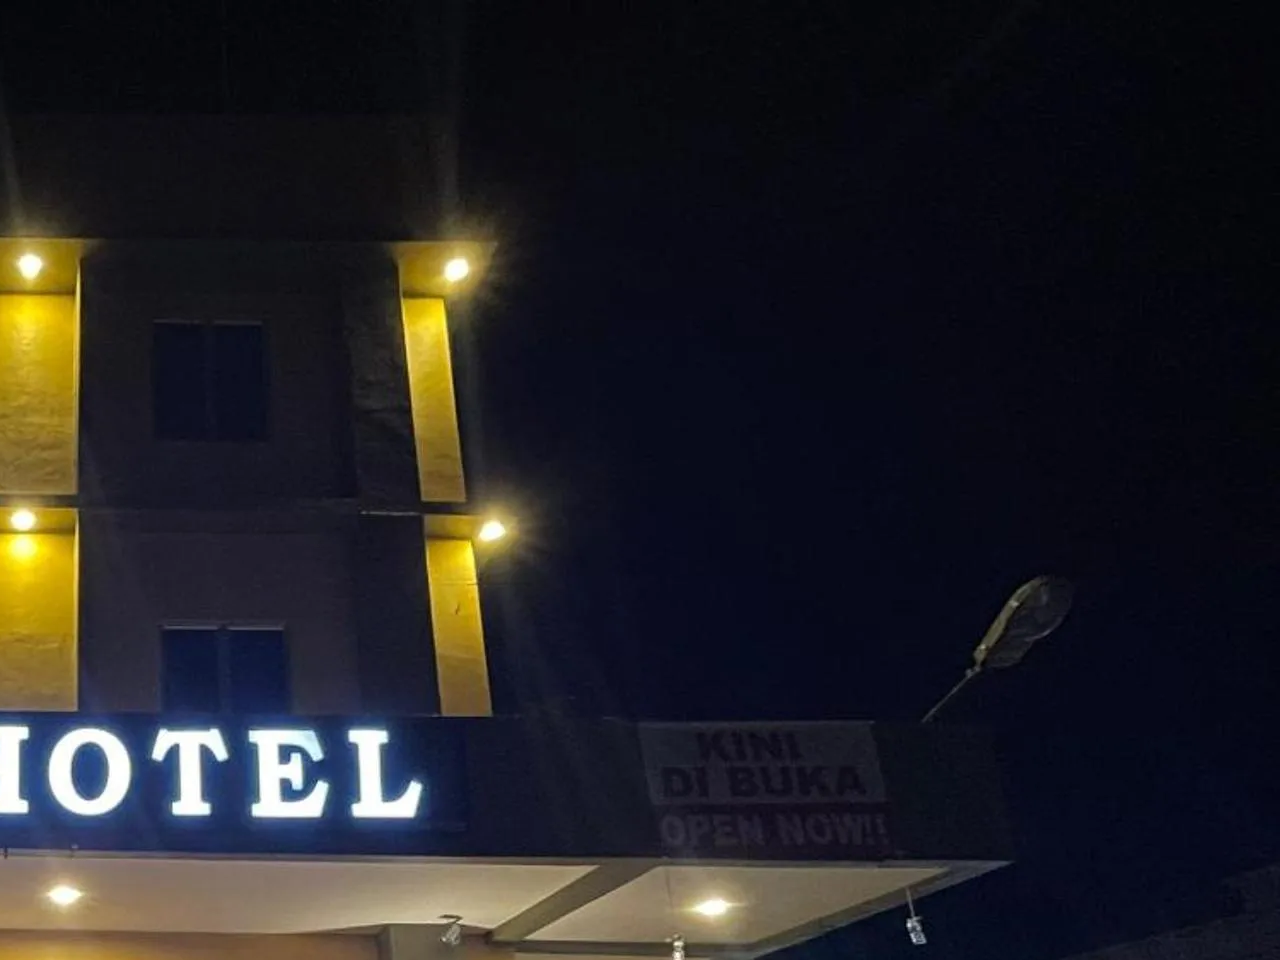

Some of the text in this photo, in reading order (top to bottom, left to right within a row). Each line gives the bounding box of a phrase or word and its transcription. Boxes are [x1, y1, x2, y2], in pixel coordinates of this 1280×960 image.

[697, 732, 804, 762] KINI
[662, 766, 868, 797] DI BUKA
[661, 813, 766, 847] OPEN
